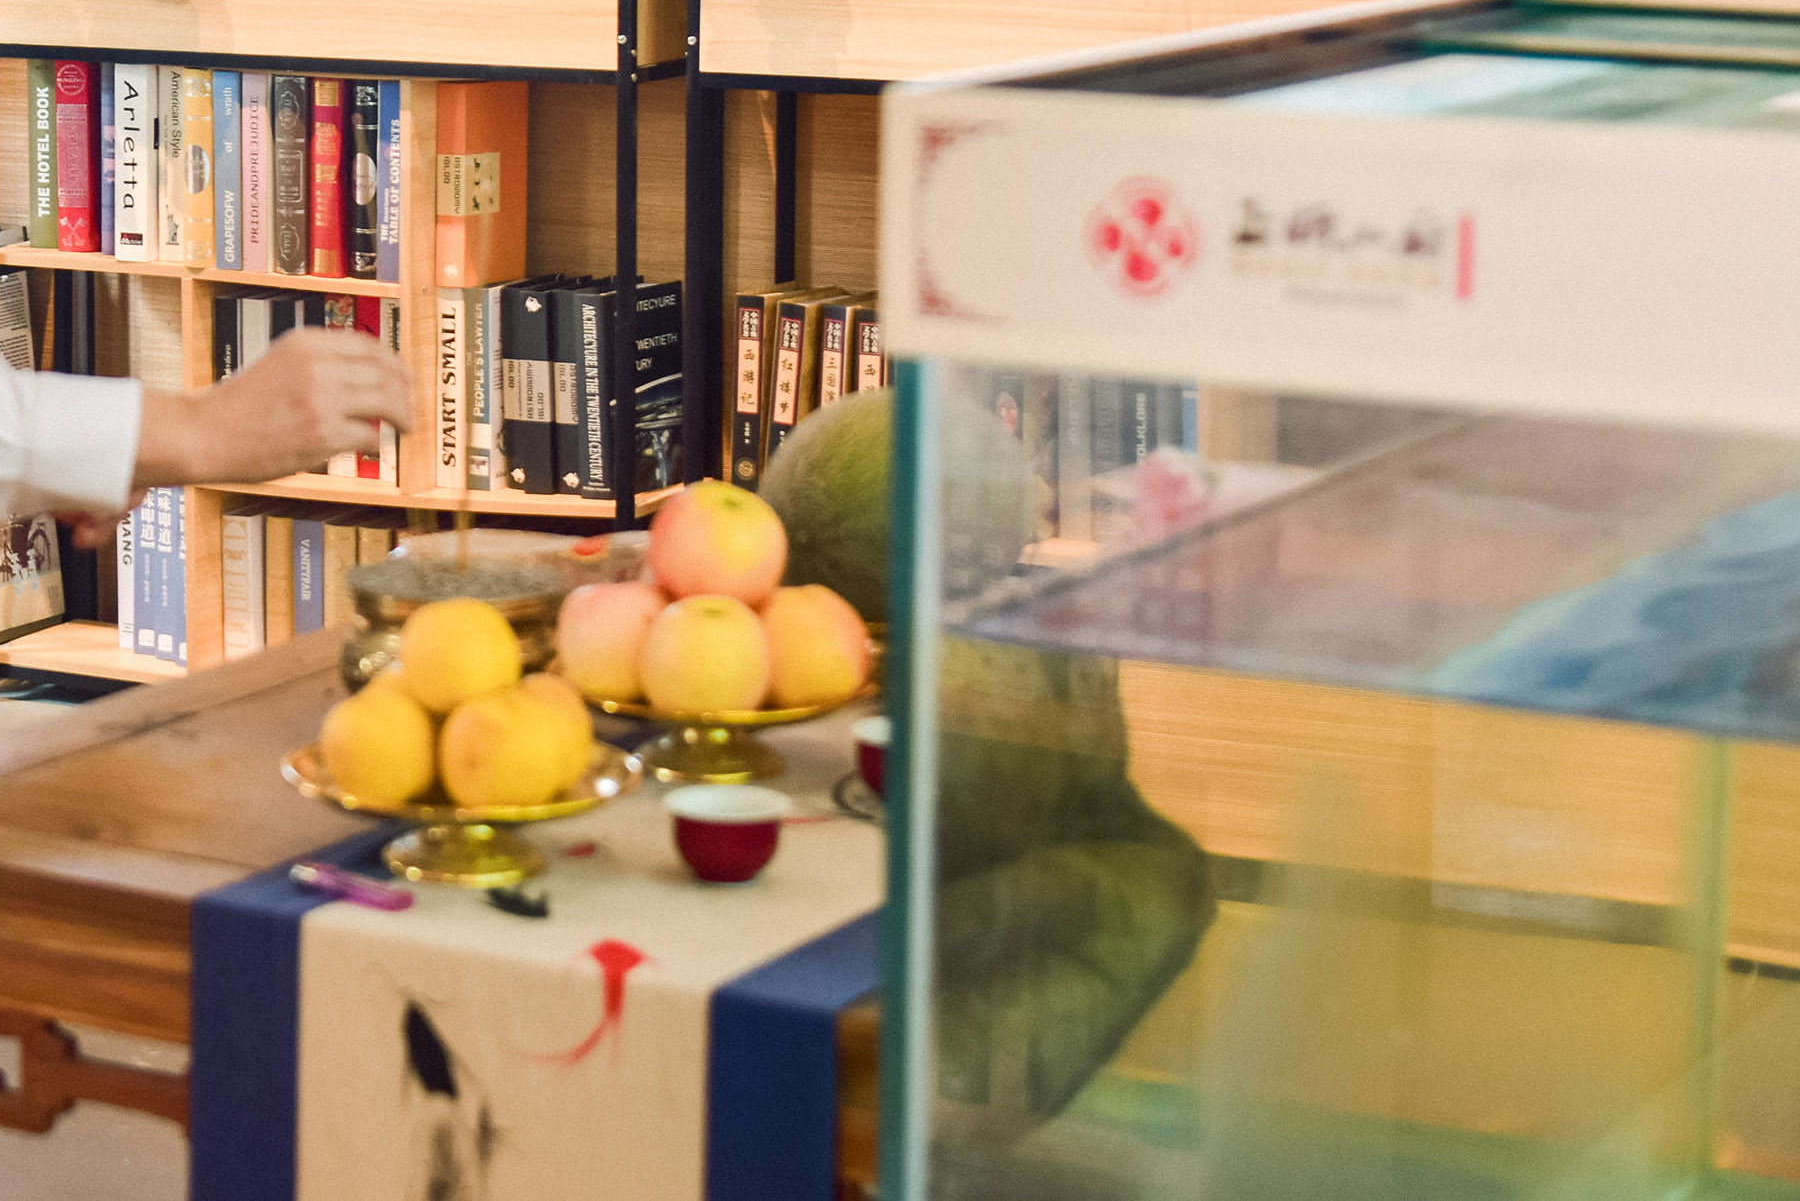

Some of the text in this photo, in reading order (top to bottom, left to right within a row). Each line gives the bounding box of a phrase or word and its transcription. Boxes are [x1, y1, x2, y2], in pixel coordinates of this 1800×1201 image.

[123, 81, 140, 210] Arletta
[171, 71, 182, 158] American Style
[37, 86, 50, 217] THE HOTEL BOOK
[224, 87, 235, 263] wrath of GRAPESOFW
[390, 119, 400, 184] CONTENTS
[389, 205, 399, 244] TABLE
[474, 303, 483, 355] LAWYER
[442, 307, 456, 467] START SMALL
[585, 376, 599, 392] THE
[586, 395, 601, 441] TWENTIETH
[589, 442, 604, 481] CENTURY
